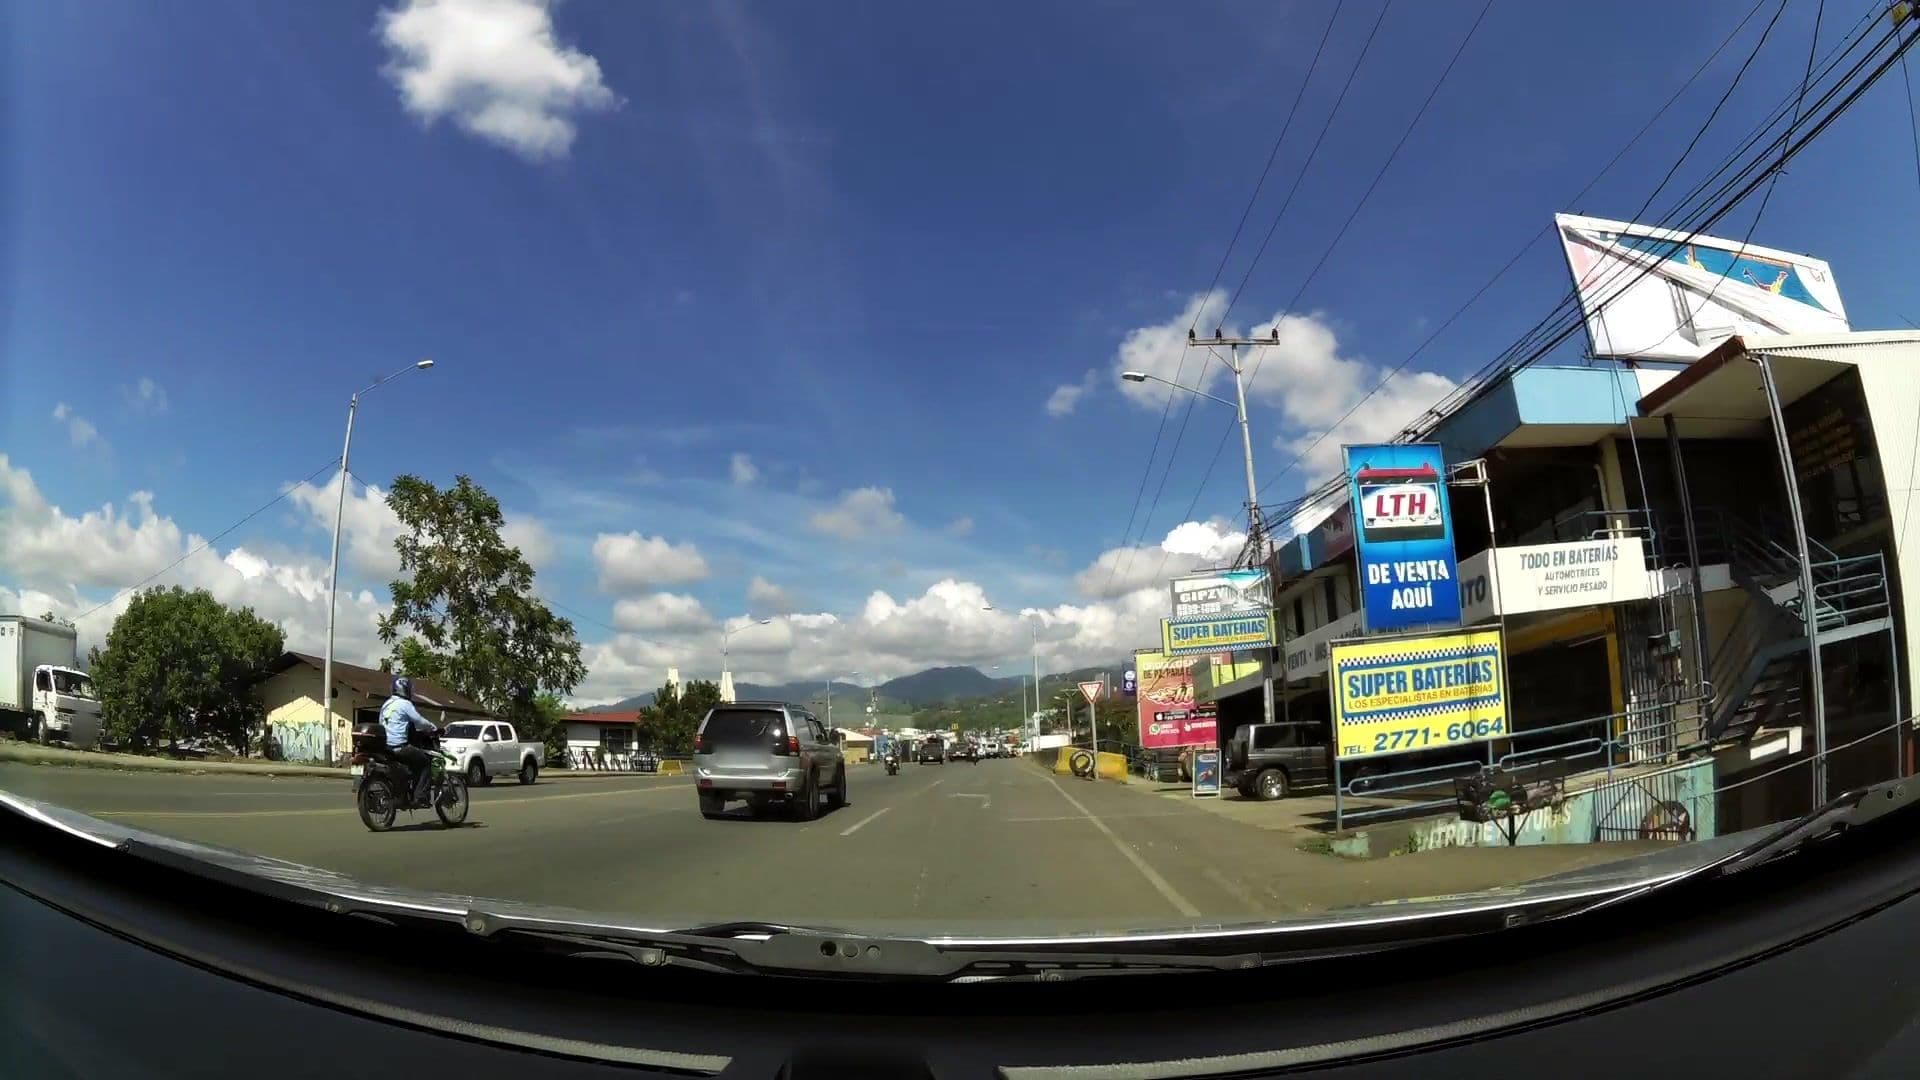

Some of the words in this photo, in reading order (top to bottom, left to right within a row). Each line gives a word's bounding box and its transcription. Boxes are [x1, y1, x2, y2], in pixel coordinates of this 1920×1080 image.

[1376, 493, 1426, 517] LTH
[1520, 551, 1550, 569] TODO
[1553, 550, 1566, 567] EN
[1569, 544, 1618, 565] BATERÍAS
[1367, 563, 1391, 584] DE
[1394, 560, 1449, 582] VENTA
[1545, 567, 1600, 580] AUTOMOTRICES
[1391, 582, 1433, 609] AQUÍ
[1538, 586, 1543, 596] Y
[1545, 584, 1578, 595] SERVICIO
[1580, 581, 1608, 592] PESADO
[1174, 625, 1209, 640] SUPER
[1349, 671, 1407, 698] SUPER
[1412, 660, 1493, 691] BATERIAS
[1349, 699, 1368, 709] LOS
[1370, 692, 1437, 707] ESPECIALISTAS
[1439, 689, 1451, 698] EN
[1343, 745, 1367, 755] TEL:
